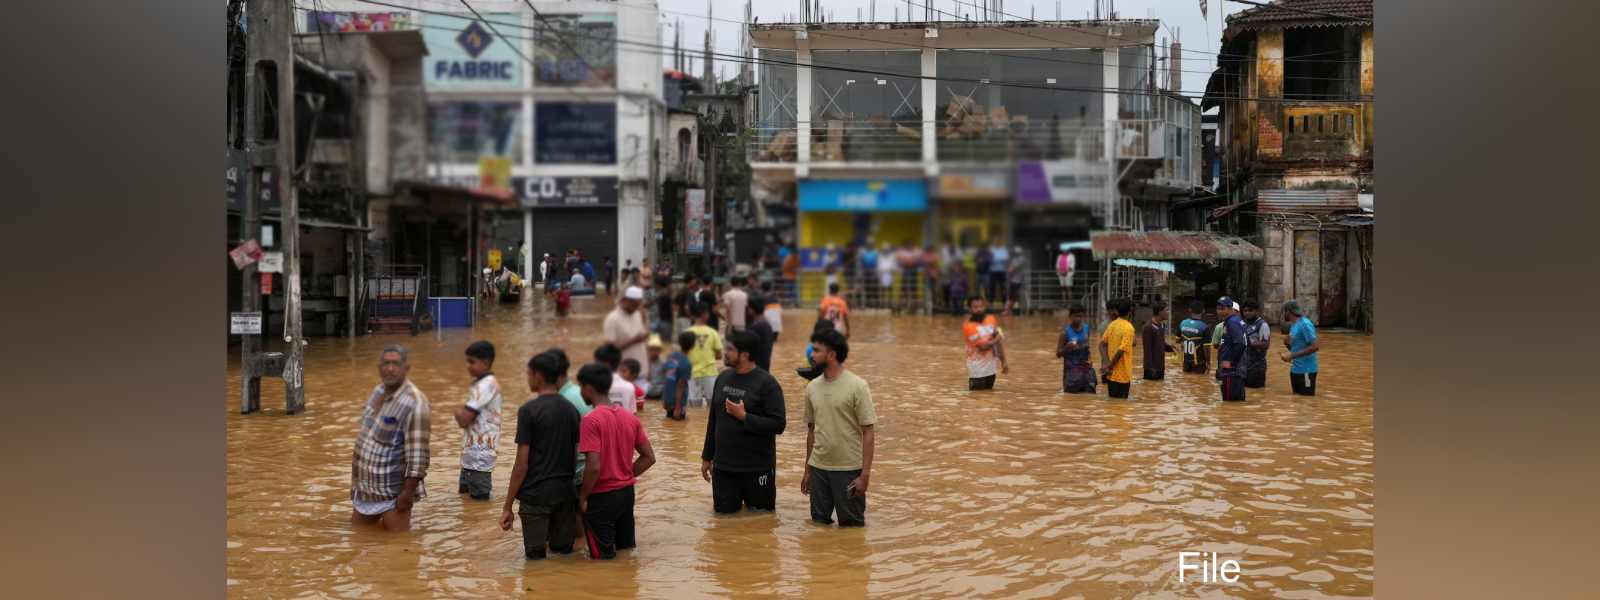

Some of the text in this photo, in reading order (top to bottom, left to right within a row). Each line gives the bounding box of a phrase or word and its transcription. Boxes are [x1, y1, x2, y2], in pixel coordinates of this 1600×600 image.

[435, 61, 512, 80] FABRIC
[525, 177, 562, 198] CO.
[1183, 340, 1195, 354] 10
